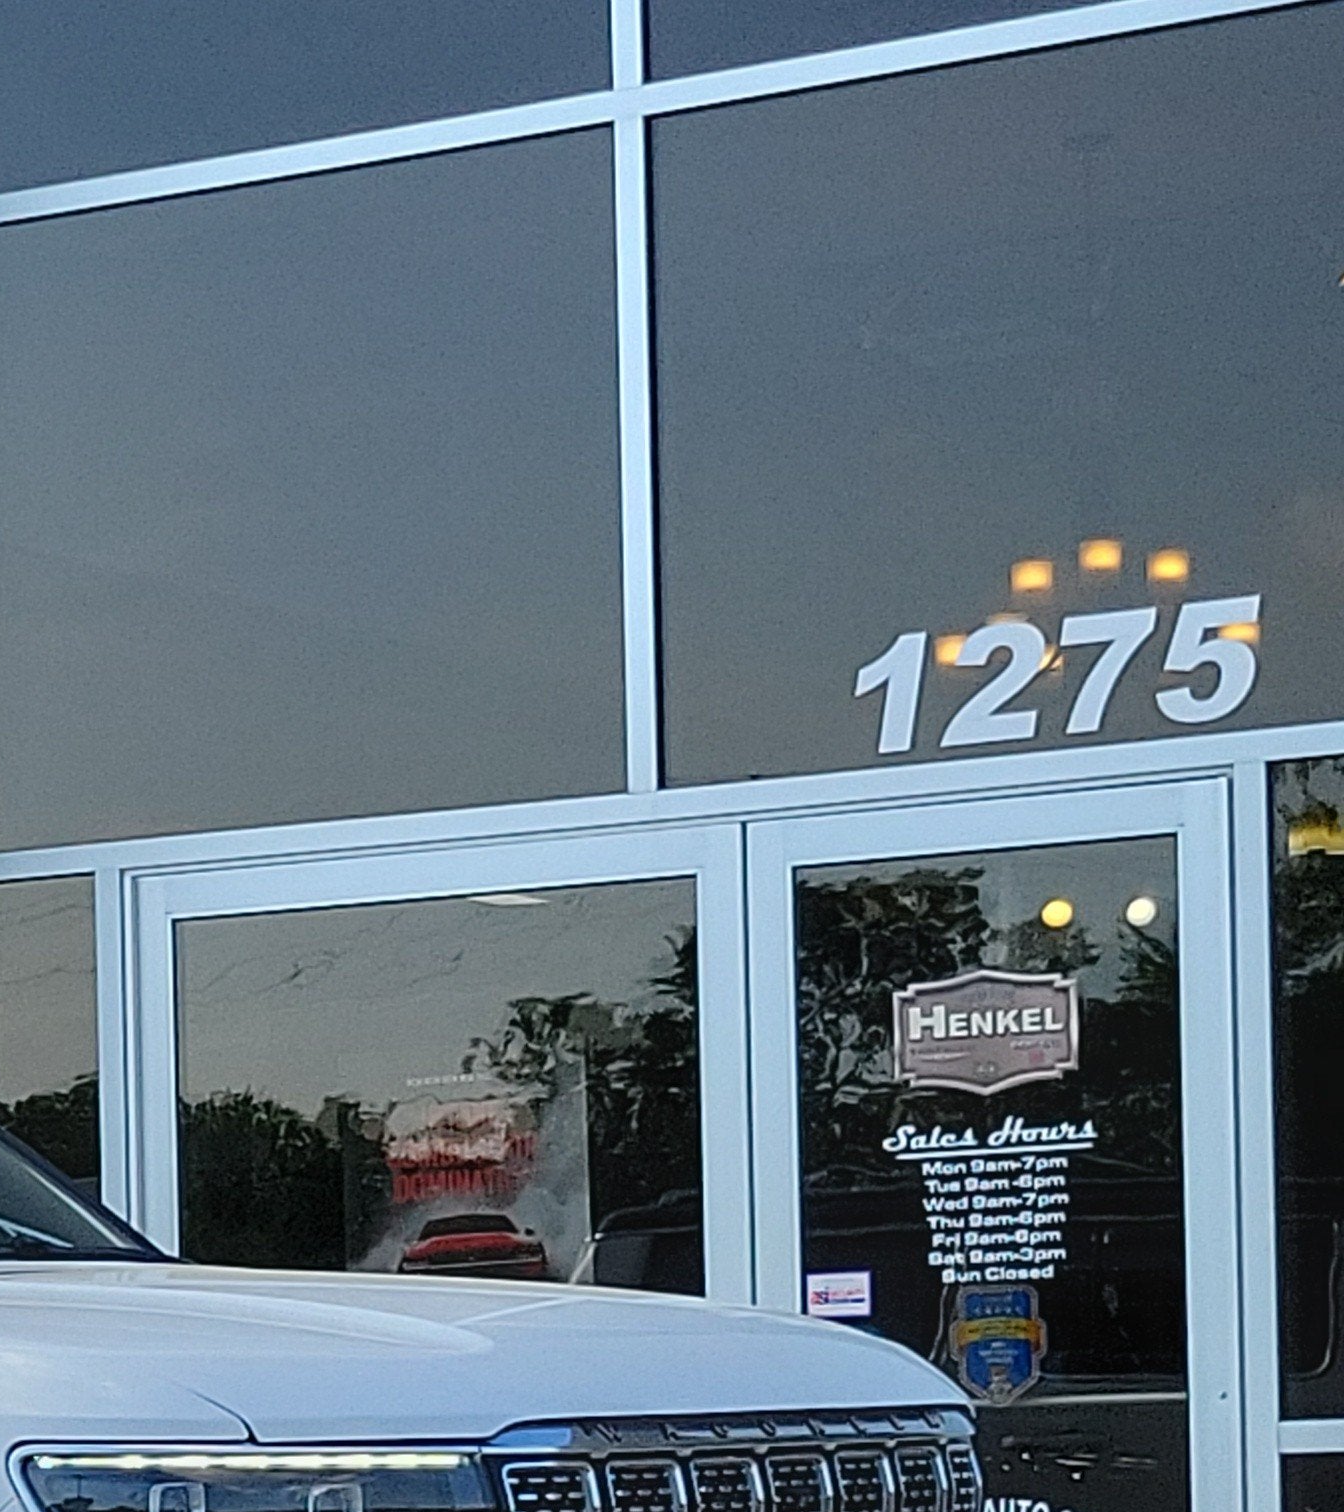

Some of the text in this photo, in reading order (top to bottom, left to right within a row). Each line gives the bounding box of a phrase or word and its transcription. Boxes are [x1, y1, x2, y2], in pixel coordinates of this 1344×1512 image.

[853, 593, 1261, 755] 1275
[907, 1004, 1064, 1041] HENKEL
[882, 1115, 1099, 1151] Sales Hours
[921, 1156, 1069, 1176] Mon 9am-7pm
[924, 1179, 961, 1194] Tue
[922, 1193, 1070, 1212] Wed 9am-7pm
[926, 1216, 965, 1230] Thu
[932, 1233, 961, 1248] Fri
[928, 1252, 965, 1266] Sat
[941, 1264, 1055, 1284] Sun Closed
